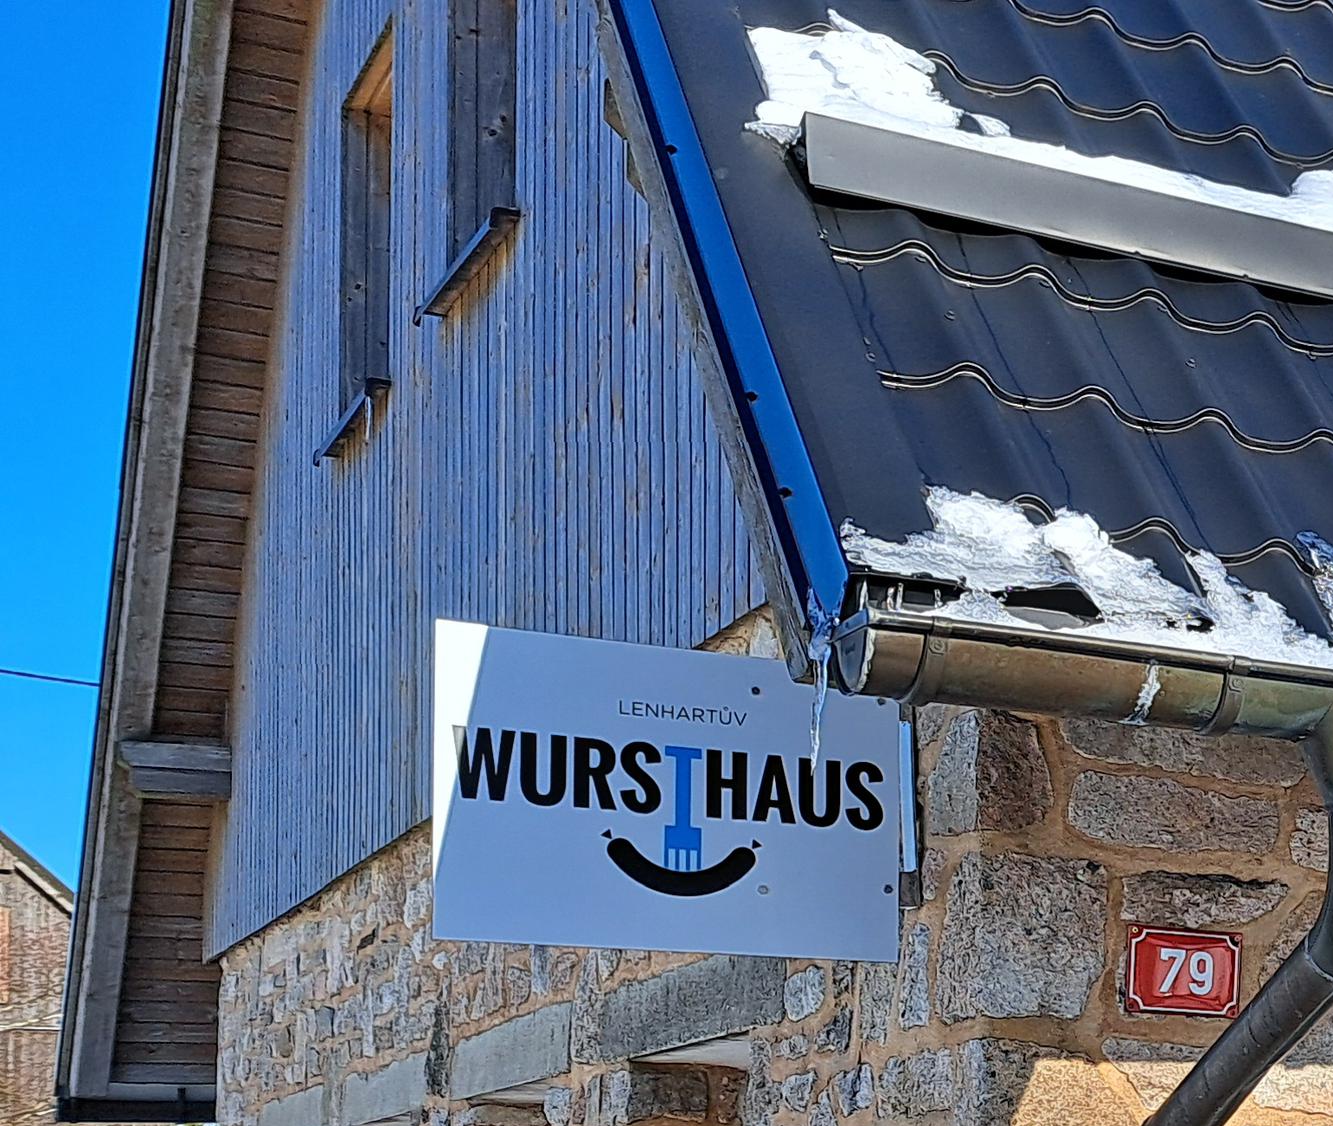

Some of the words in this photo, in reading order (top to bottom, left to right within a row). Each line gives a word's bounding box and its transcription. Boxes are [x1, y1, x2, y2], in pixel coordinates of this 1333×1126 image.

[619, 699, 747, 726] LENHARTŮV
[452, 724, 885, 831] WURSTHAUS
[1159, 948, 1214, 995] 79
